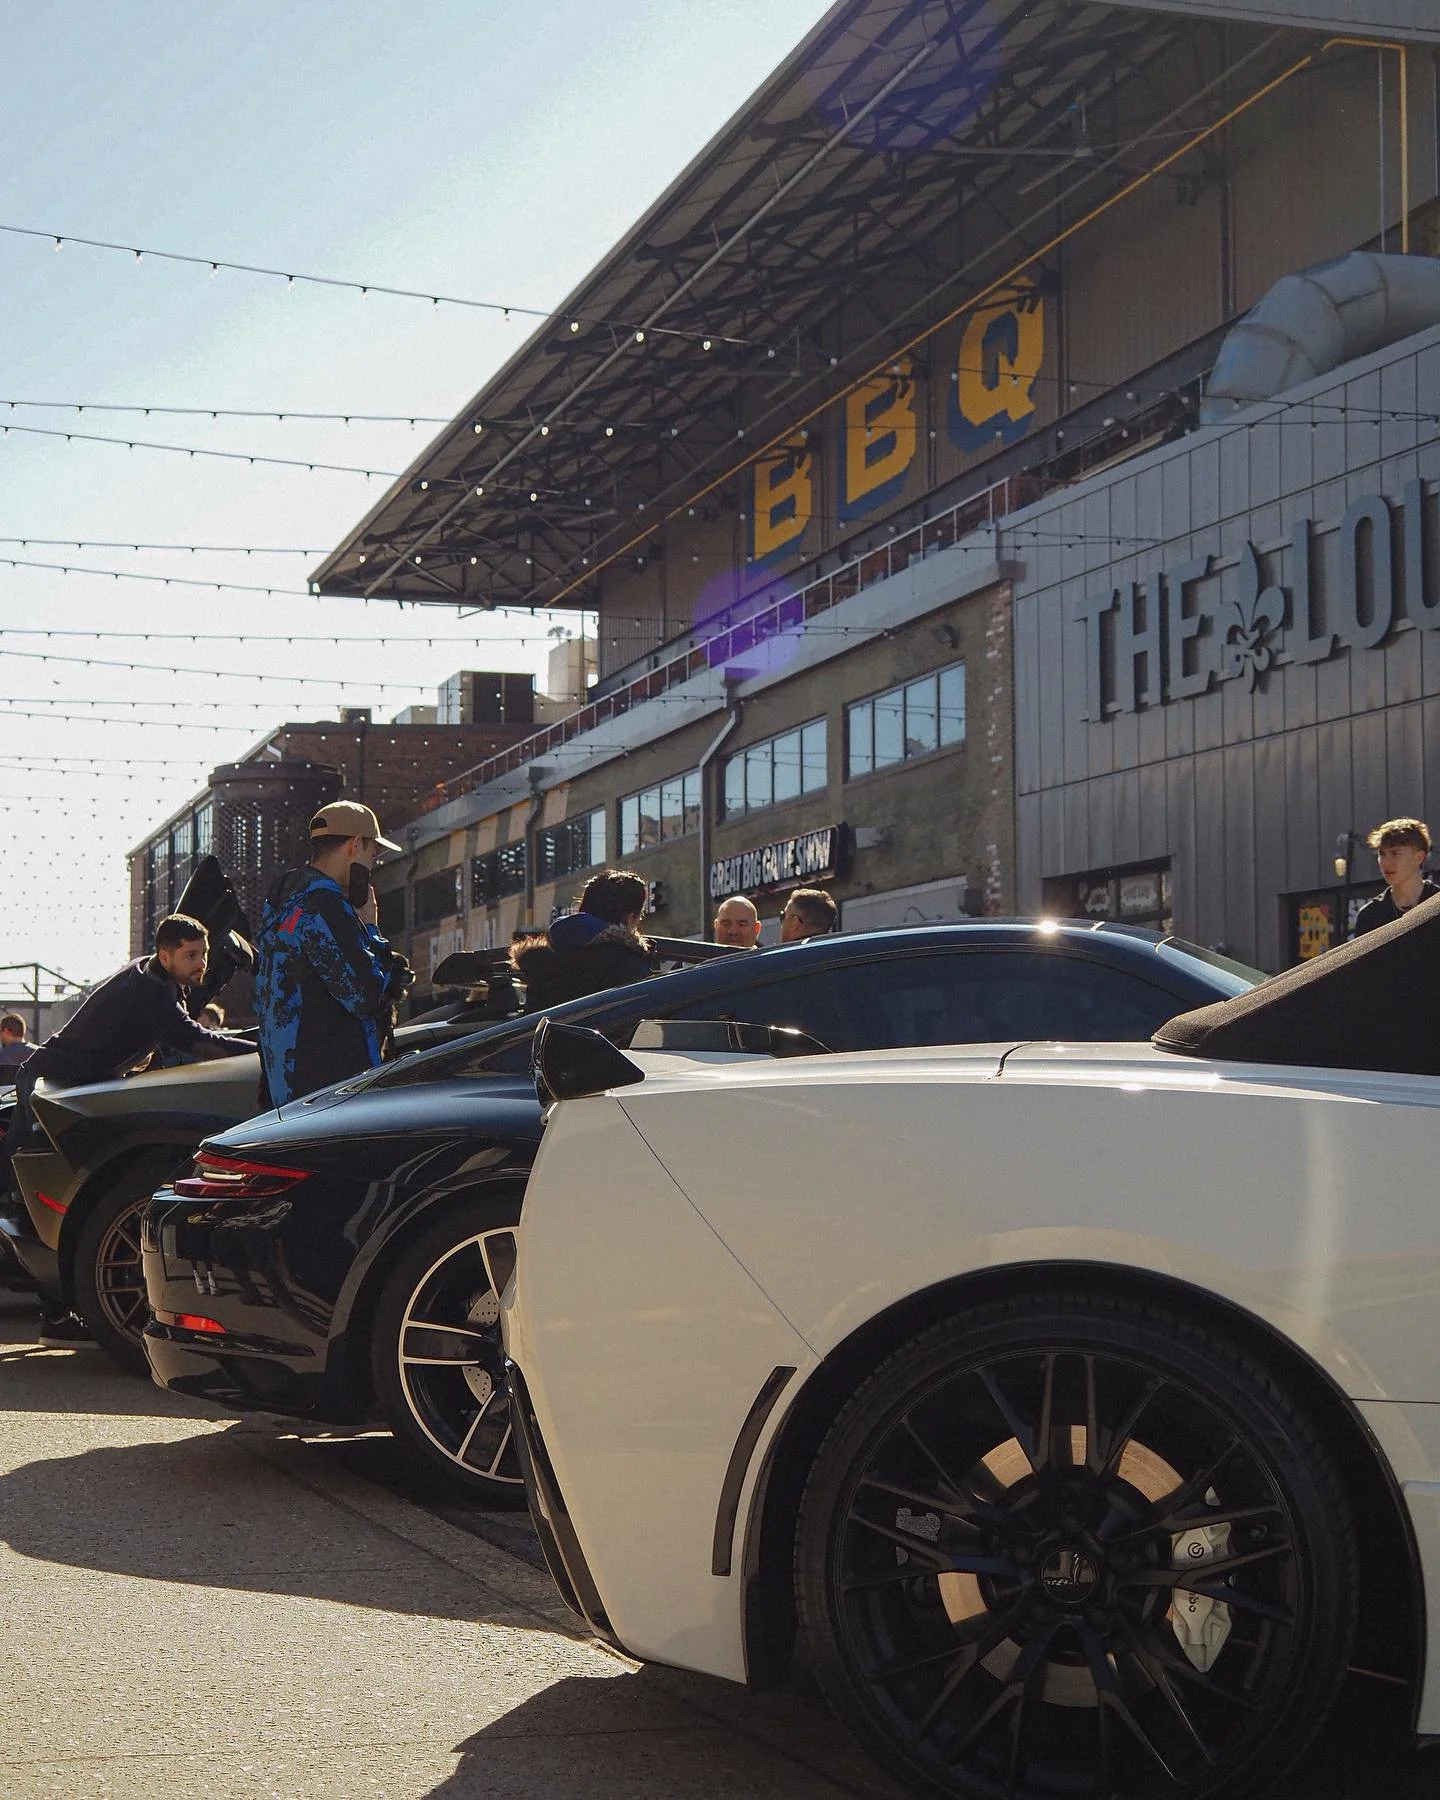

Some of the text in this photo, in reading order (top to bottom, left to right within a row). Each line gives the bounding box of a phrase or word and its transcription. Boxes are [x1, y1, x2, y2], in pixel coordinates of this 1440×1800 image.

[1074, 555, 1212, 722] THE
[710, 829, 831, 897] GREAT BIG GAME SHOW
